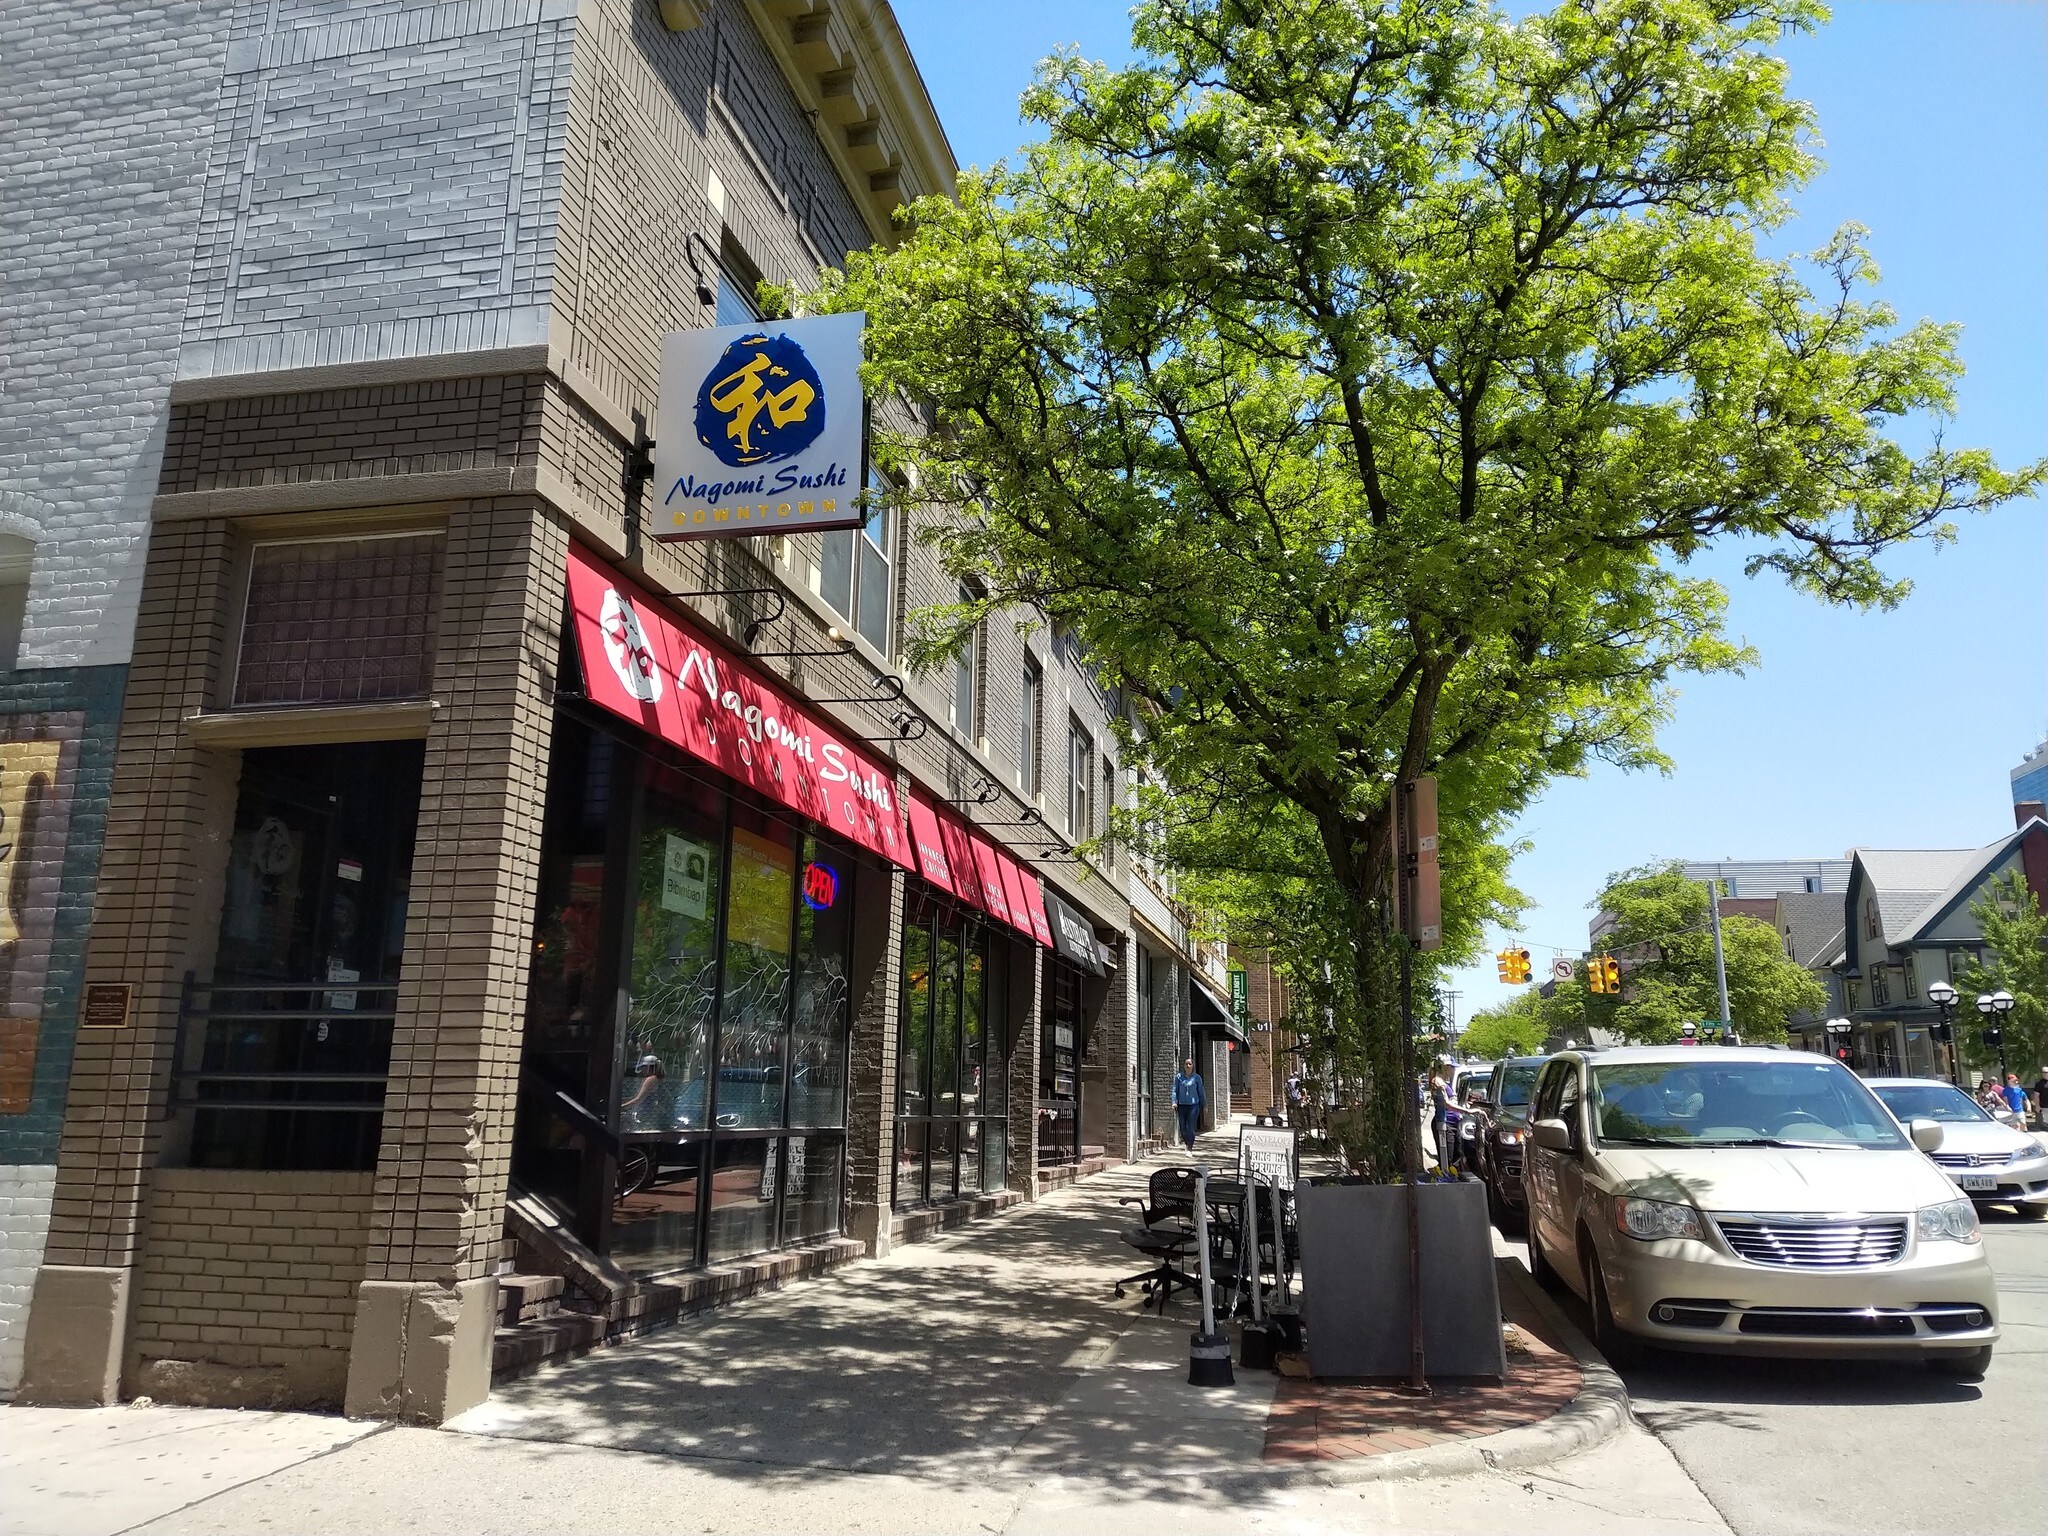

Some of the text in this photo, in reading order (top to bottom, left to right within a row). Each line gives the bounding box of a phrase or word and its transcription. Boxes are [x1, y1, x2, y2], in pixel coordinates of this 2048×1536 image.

[710, 352, 815, 453] 和
[665, 462, 847, 506] Nagomi Sushi
[673, 498, 837, 526] DOWNTOWN
[677, 648, 892, 812] Nagomi Sushi
[704, 716, 895, 847] DOWNTOWN
[919, 842, 948, 868] JAPANESE
[924, 859, 948, 882] CUISINE
[804, 863, 835, 907] OPEN
[1240, 1151, 1271, 1163] SRING
